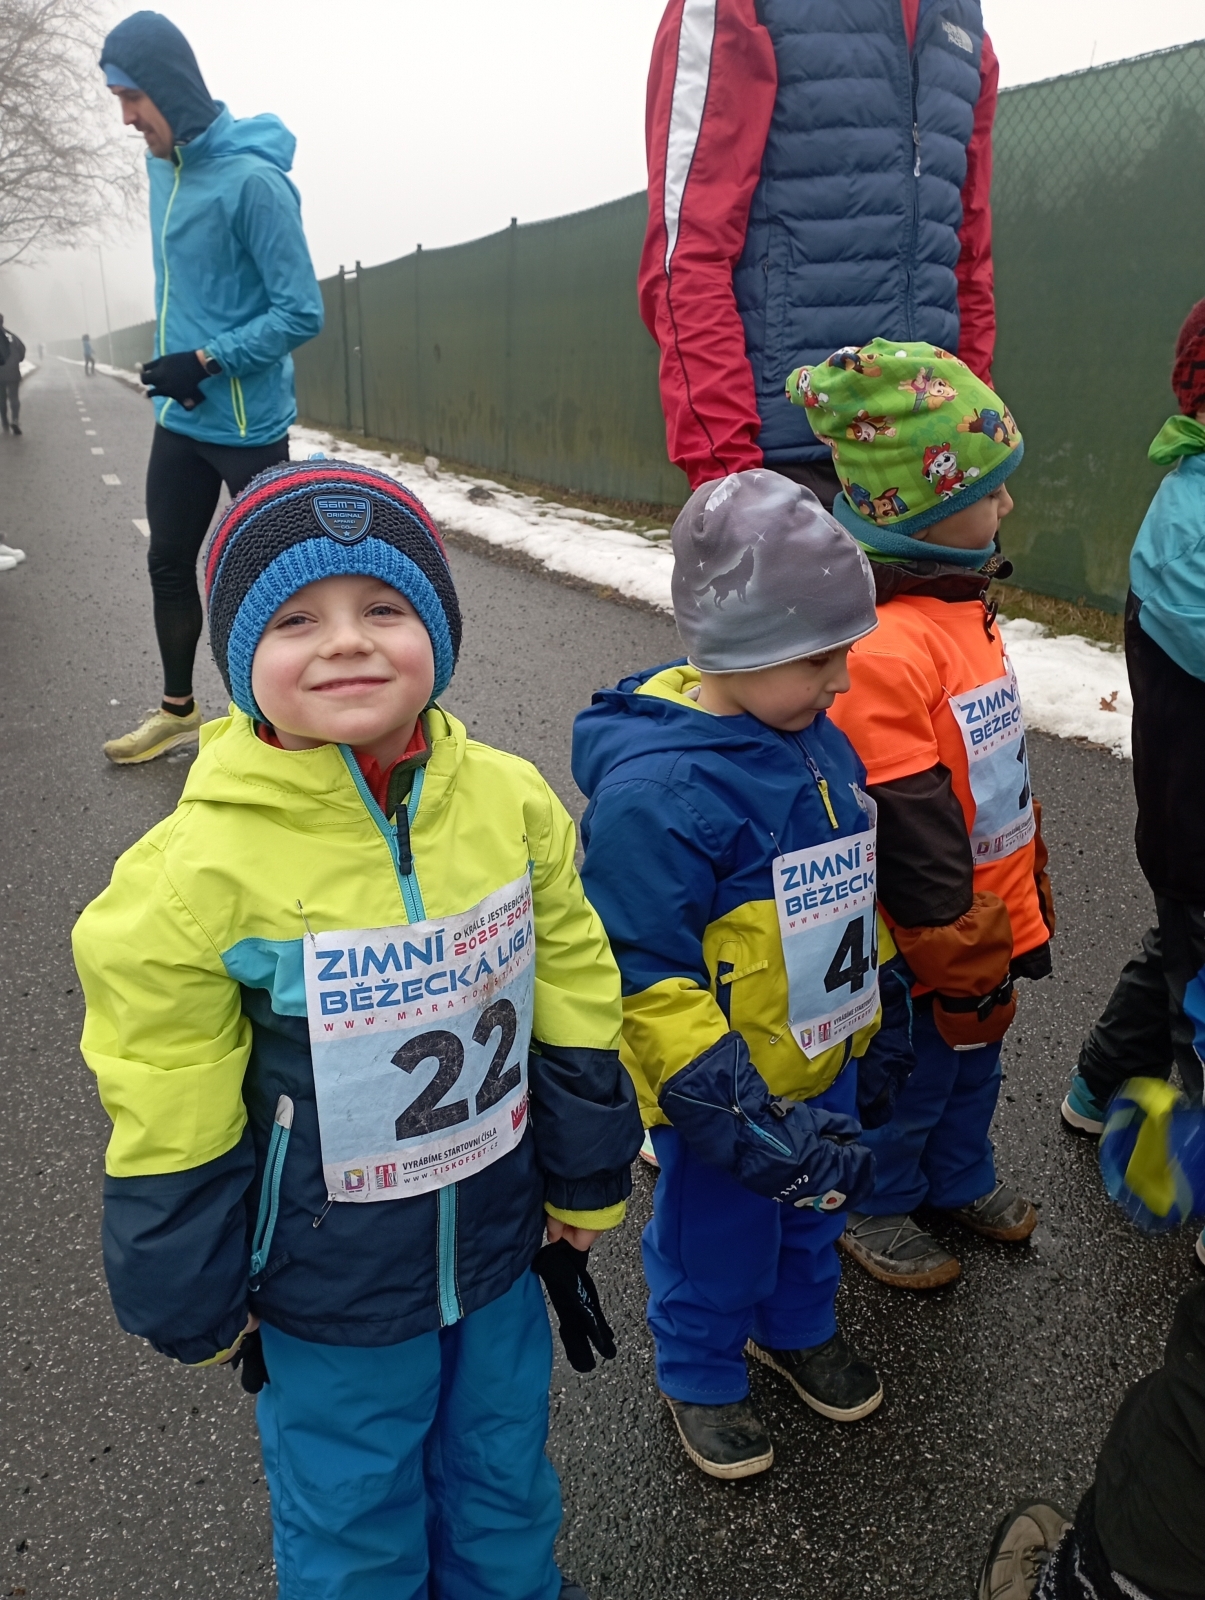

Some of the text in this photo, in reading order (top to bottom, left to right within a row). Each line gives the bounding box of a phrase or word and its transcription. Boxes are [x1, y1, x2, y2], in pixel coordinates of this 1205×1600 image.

[780, 841, 861, 892] ZIMNÍ
[785, 869, 874, 917] BĚŽECK
[453, 932, 462, 941] O
[463, 917, 486, 938] KRÁLE
[315, 928, 445, 982] ZIMNÍ
[320, 920, 532, 1015] BĚŽECKÁ LIGA
[390, 998, 522, 1141] 22
[402, 1127, 497, 1171] VYRÁBÍME STARTOVNÍ ČÍSLA
